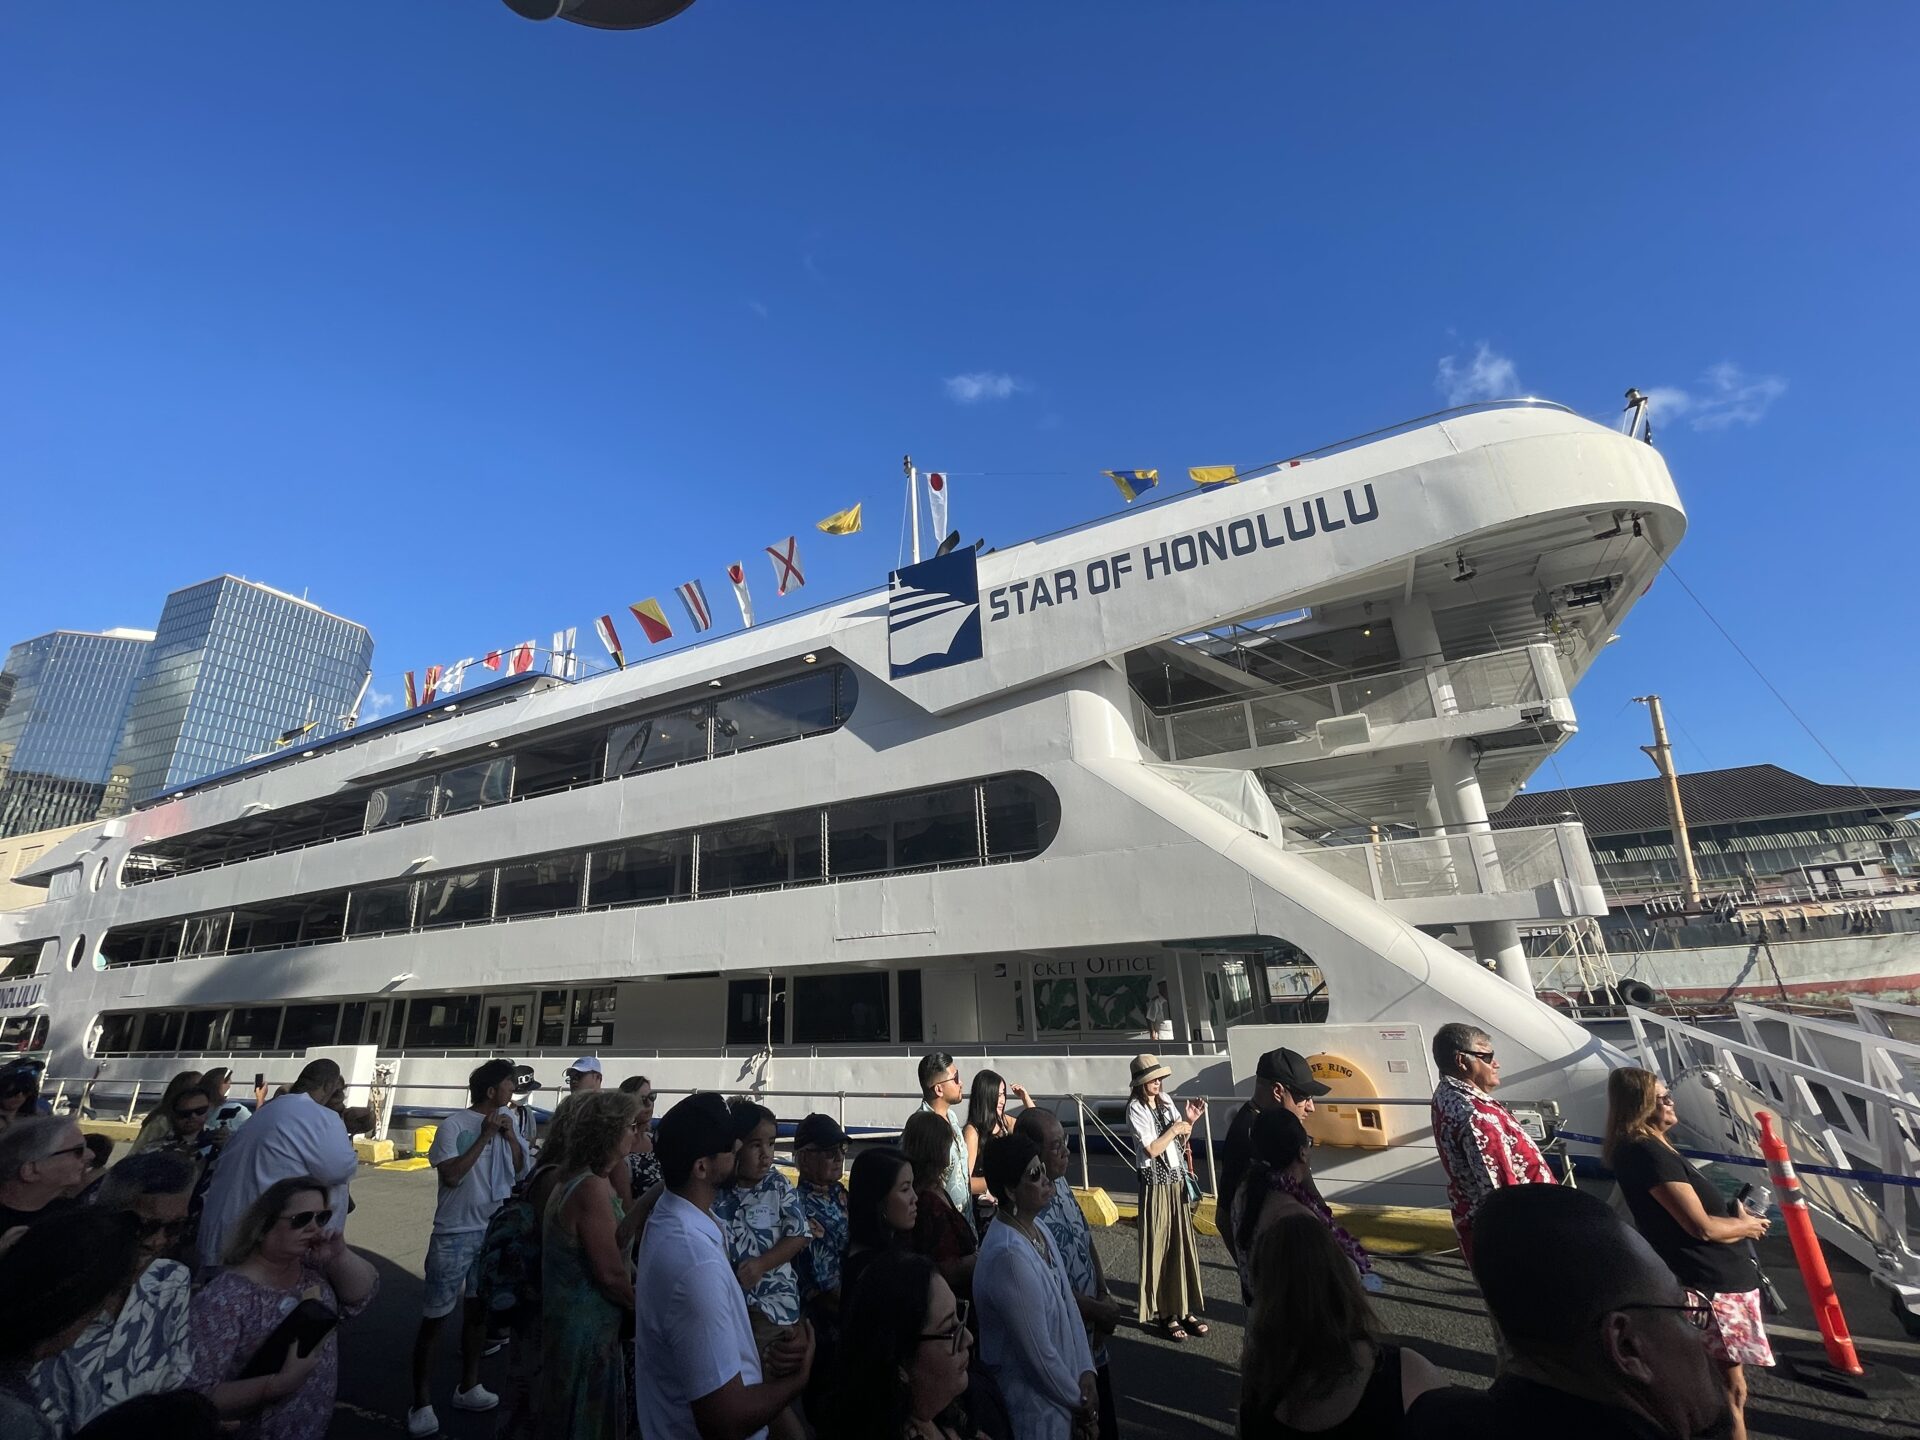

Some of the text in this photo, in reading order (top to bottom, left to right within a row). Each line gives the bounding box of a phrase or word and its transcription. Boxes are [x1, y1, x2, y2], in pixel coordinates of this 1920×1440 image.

[989, 483, 1380, 622] STAR OF HONOLULU
[1310, 1062, 1353, 1078] FE RING
